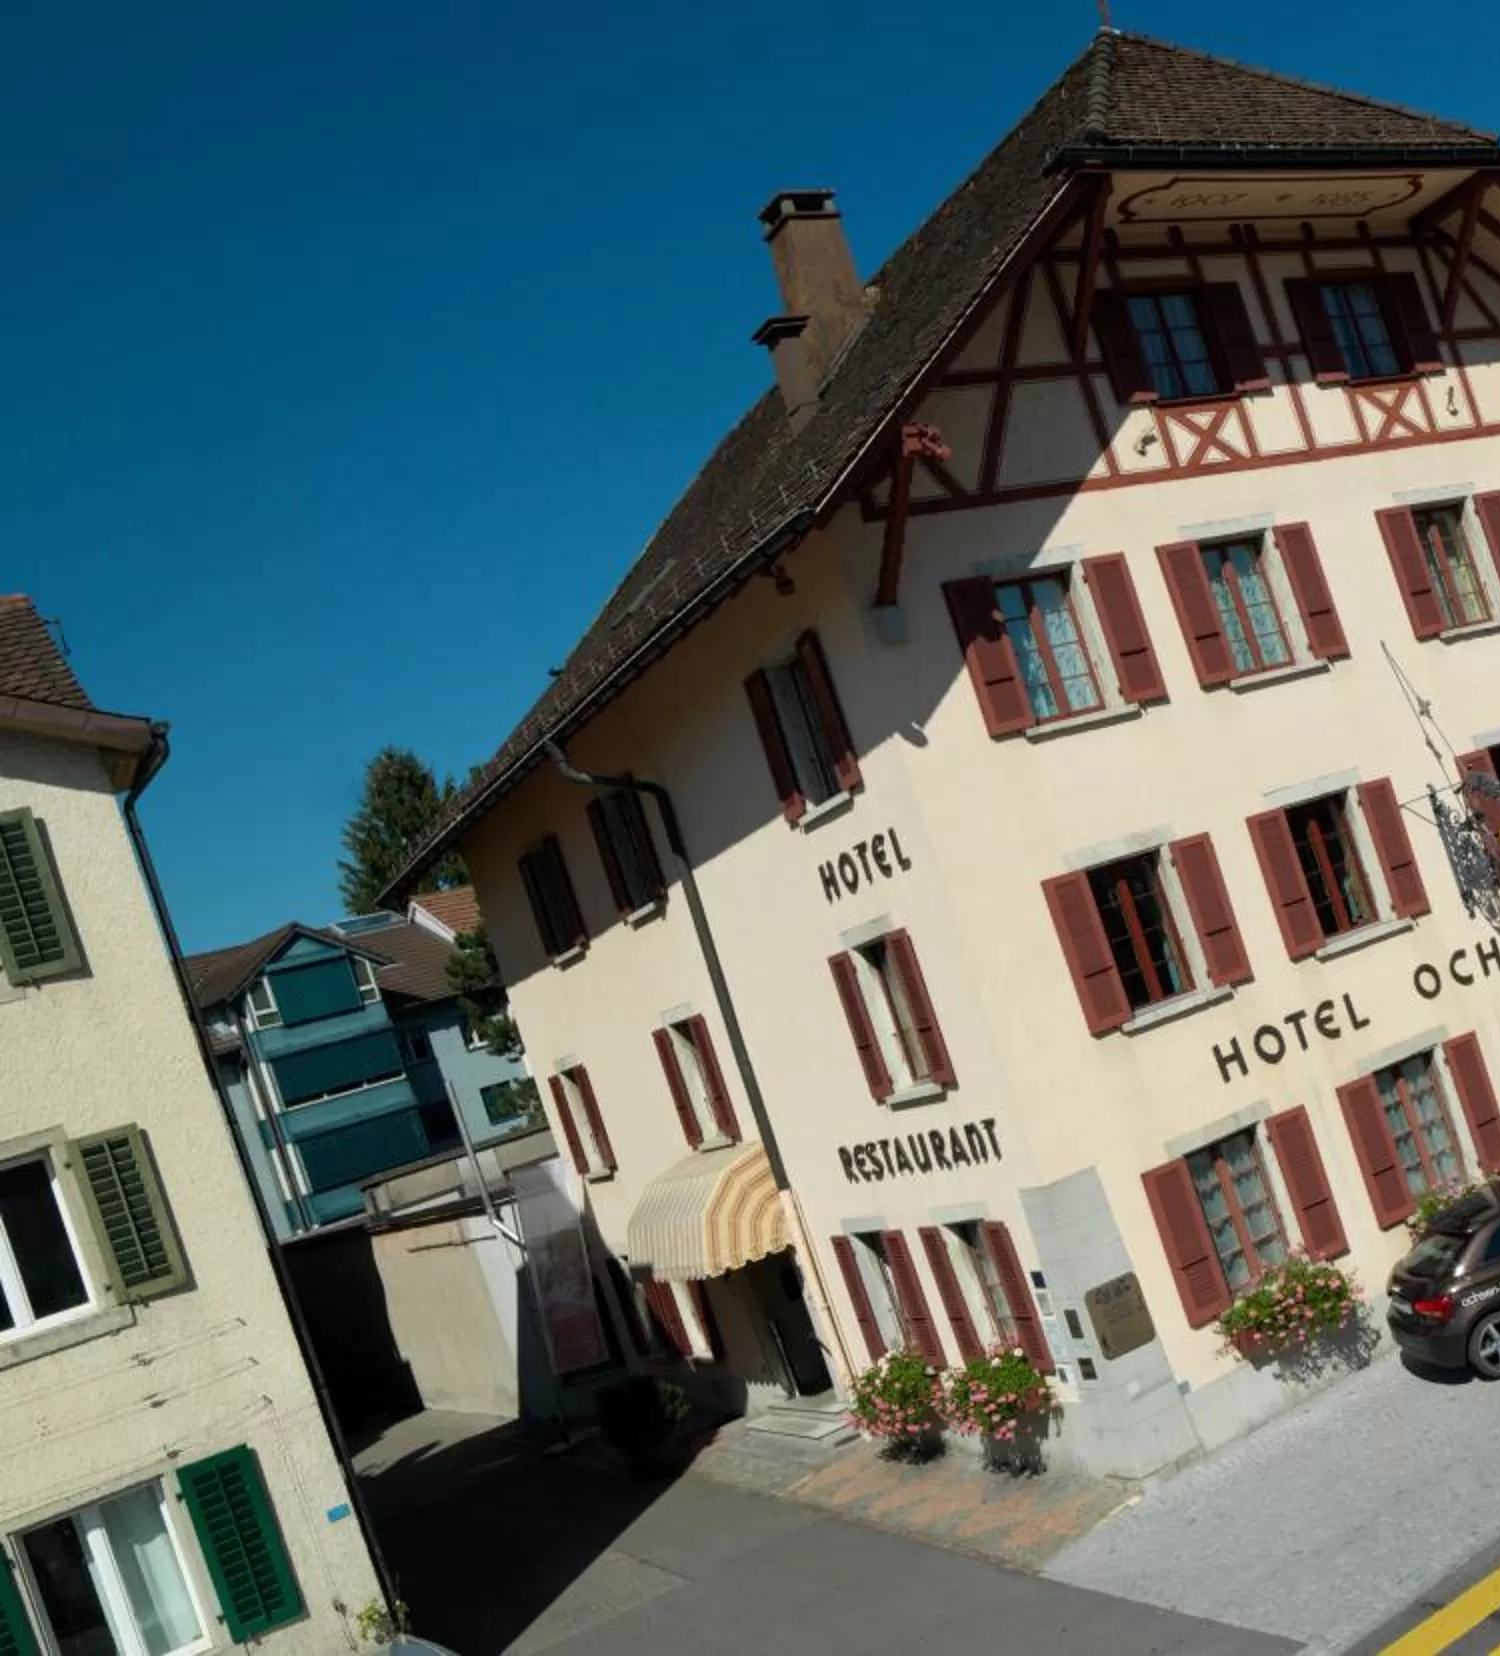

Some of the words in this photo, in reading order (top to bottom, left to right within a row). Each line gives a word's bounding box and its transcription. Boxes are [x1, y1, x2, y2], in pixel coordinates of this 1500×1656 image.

[818, 826, 912, 906] HOTEL
[1212, 993, 1370, 1084] HOTEL
[837, 1117, 1002, 1185] RESTAURANT
